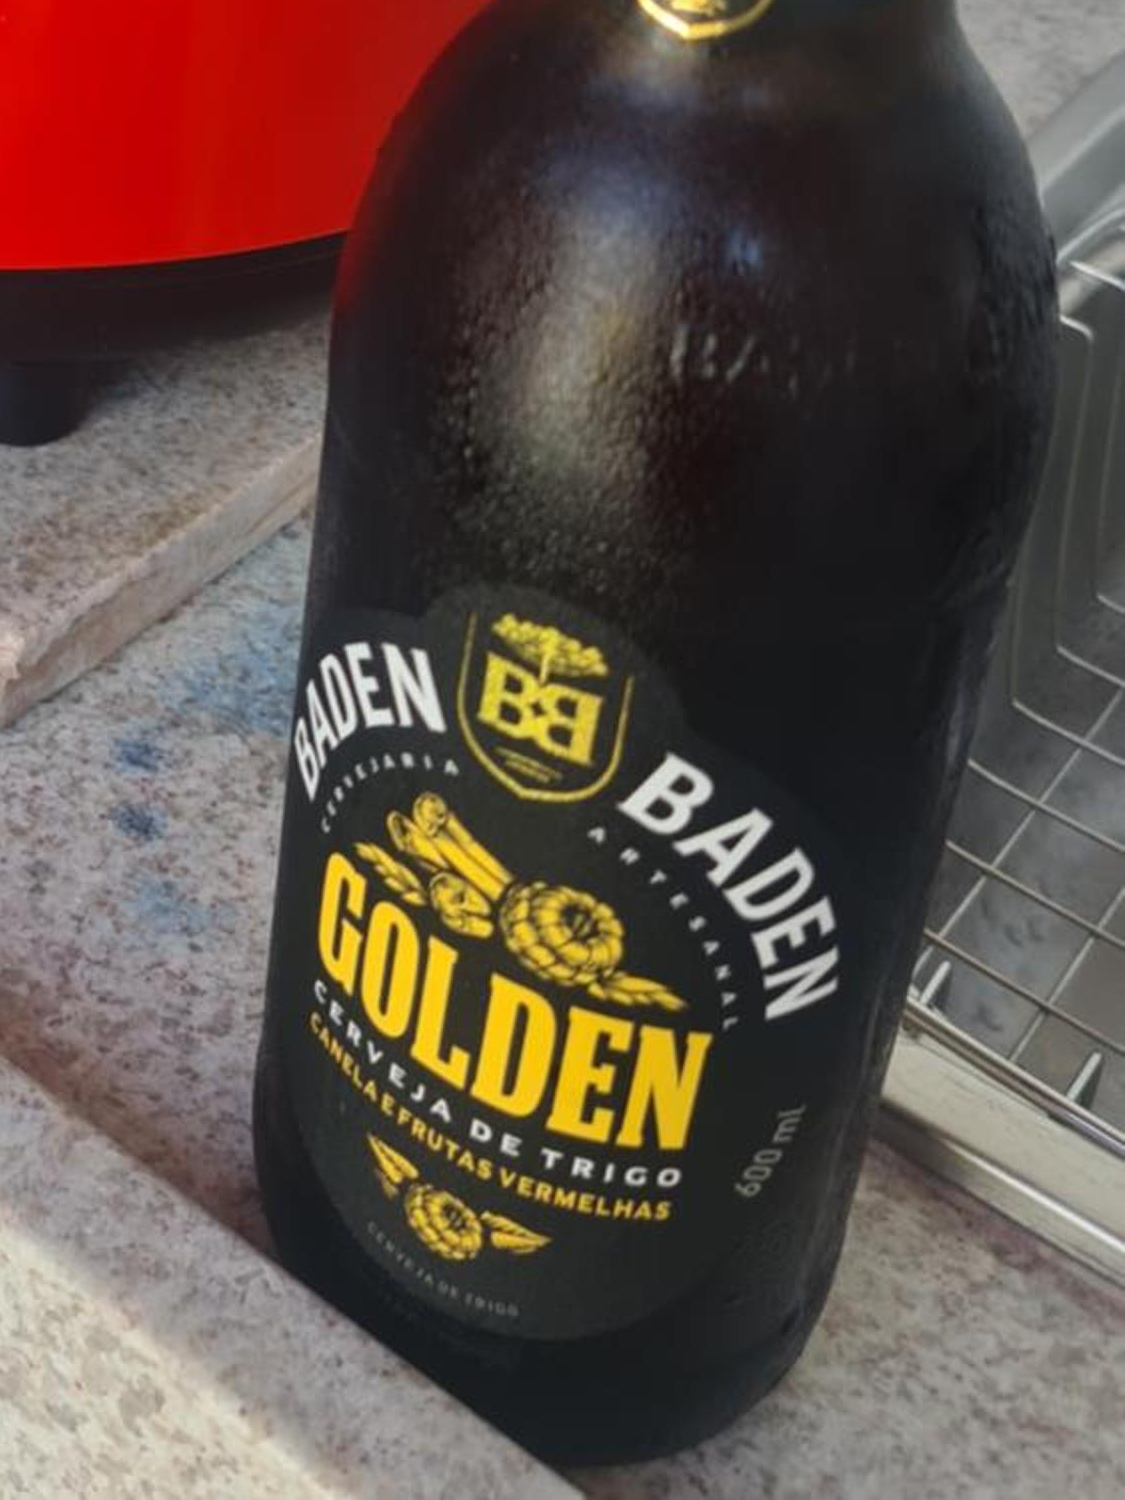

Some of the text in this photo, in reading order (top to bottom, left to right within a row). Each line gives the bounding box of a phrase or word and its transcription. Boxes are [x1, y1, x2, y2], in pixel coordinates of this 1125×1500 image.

[294, 642, 446, 802] BADEN
[588, 827, 738, 1032] ARTESANAL
[617, 752, 839, 1021] BADEN
[313, 980, 682, 1187] CERVEJA DE TRIGO
[318, 852, 713, 1150] GOLDEN
[309, 1011, 672, 1221] CANELA E FRUTAS VERMELHAS
[735, 1103, 807, 1197] 600 ml
